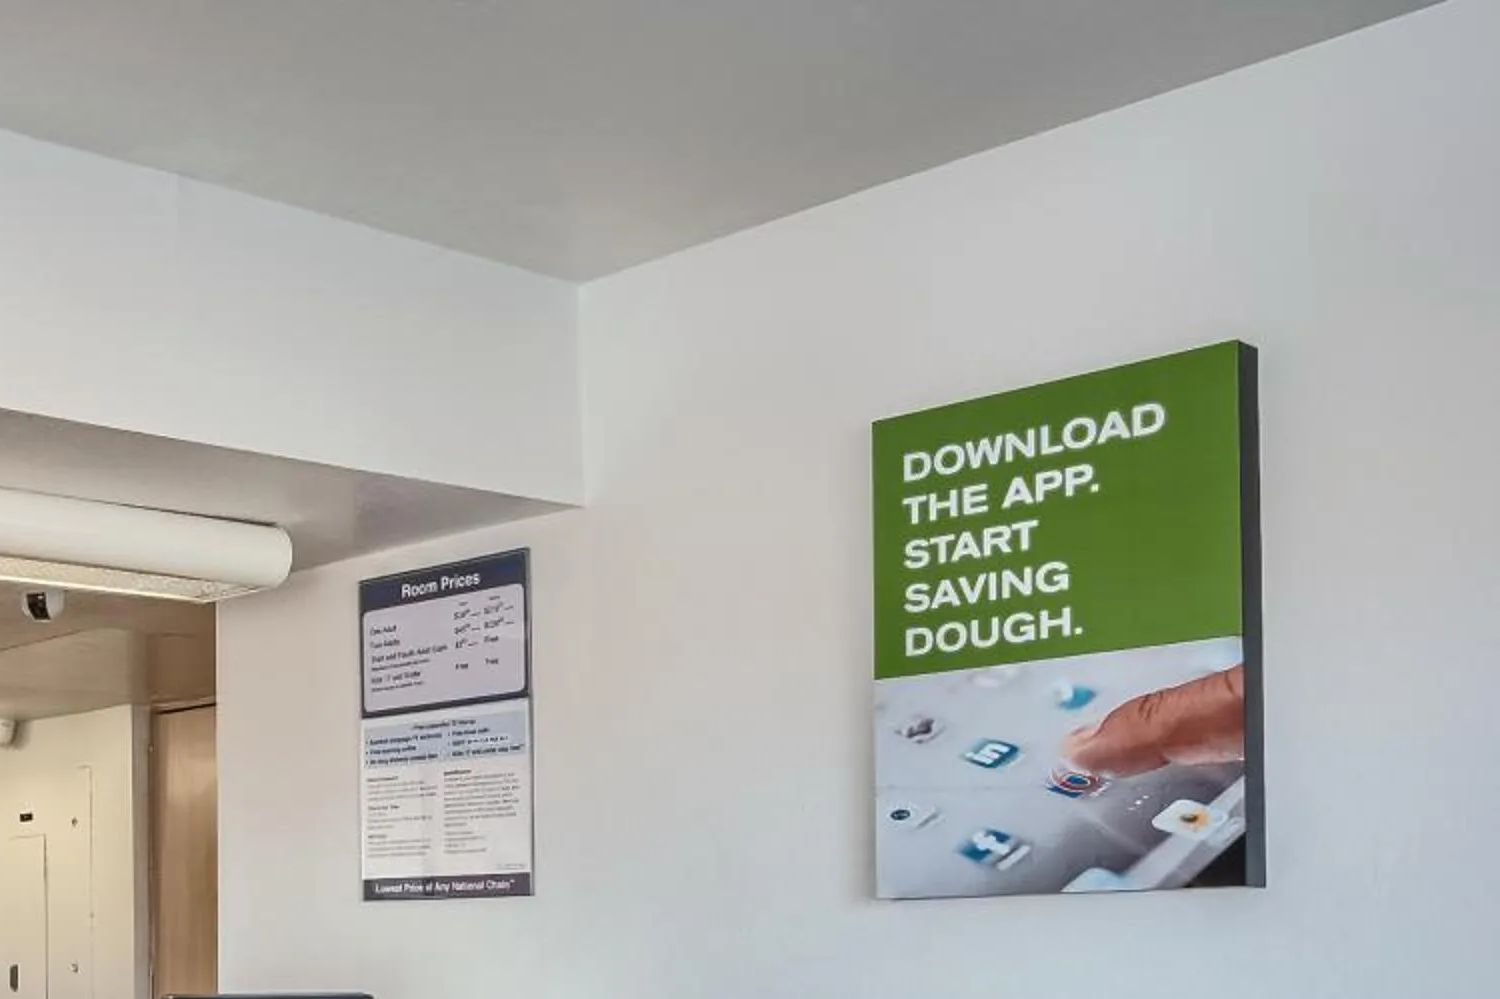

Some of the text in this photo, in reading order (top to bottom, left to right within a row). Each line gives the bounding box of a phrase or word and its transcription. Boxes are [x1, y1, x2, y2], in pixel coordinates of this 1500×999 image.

[903, 402, 1166, 483] DOWNLOAD
[902, 463, 1099, 525] THE APP.
[903, 519, 1040, 569] START
[401, 573, 480, 599] Room Prices
[903, 561, 1070, 613] SAVING
[904, 607, 1084, 657] DOUGH.
